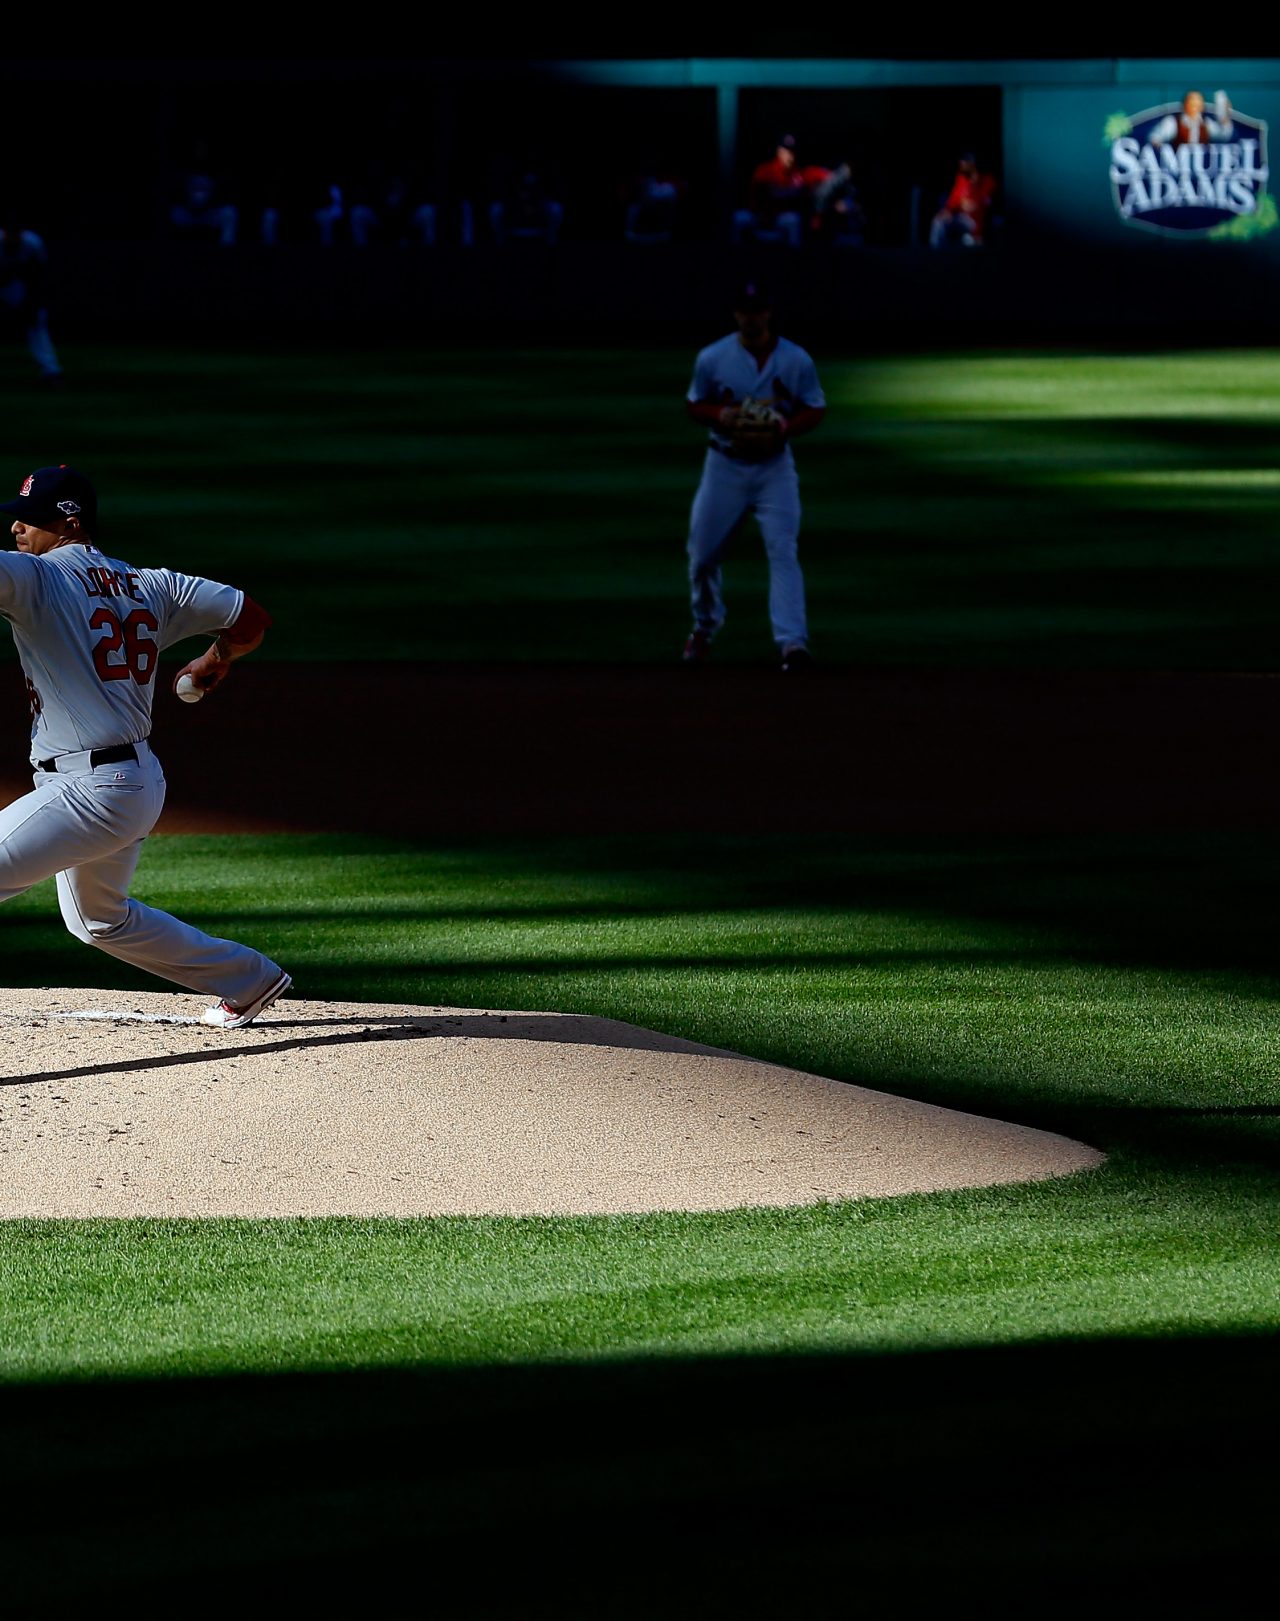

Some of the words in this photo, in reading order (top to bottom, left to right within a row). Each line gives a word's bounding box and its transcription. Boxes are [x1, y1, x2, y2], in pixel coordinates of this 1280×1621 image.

[1109, 136, 1269, 184] SAMUEL
[1121, 173, 1256, 218] ADAMS
[89, 607, 159, 685] 26
